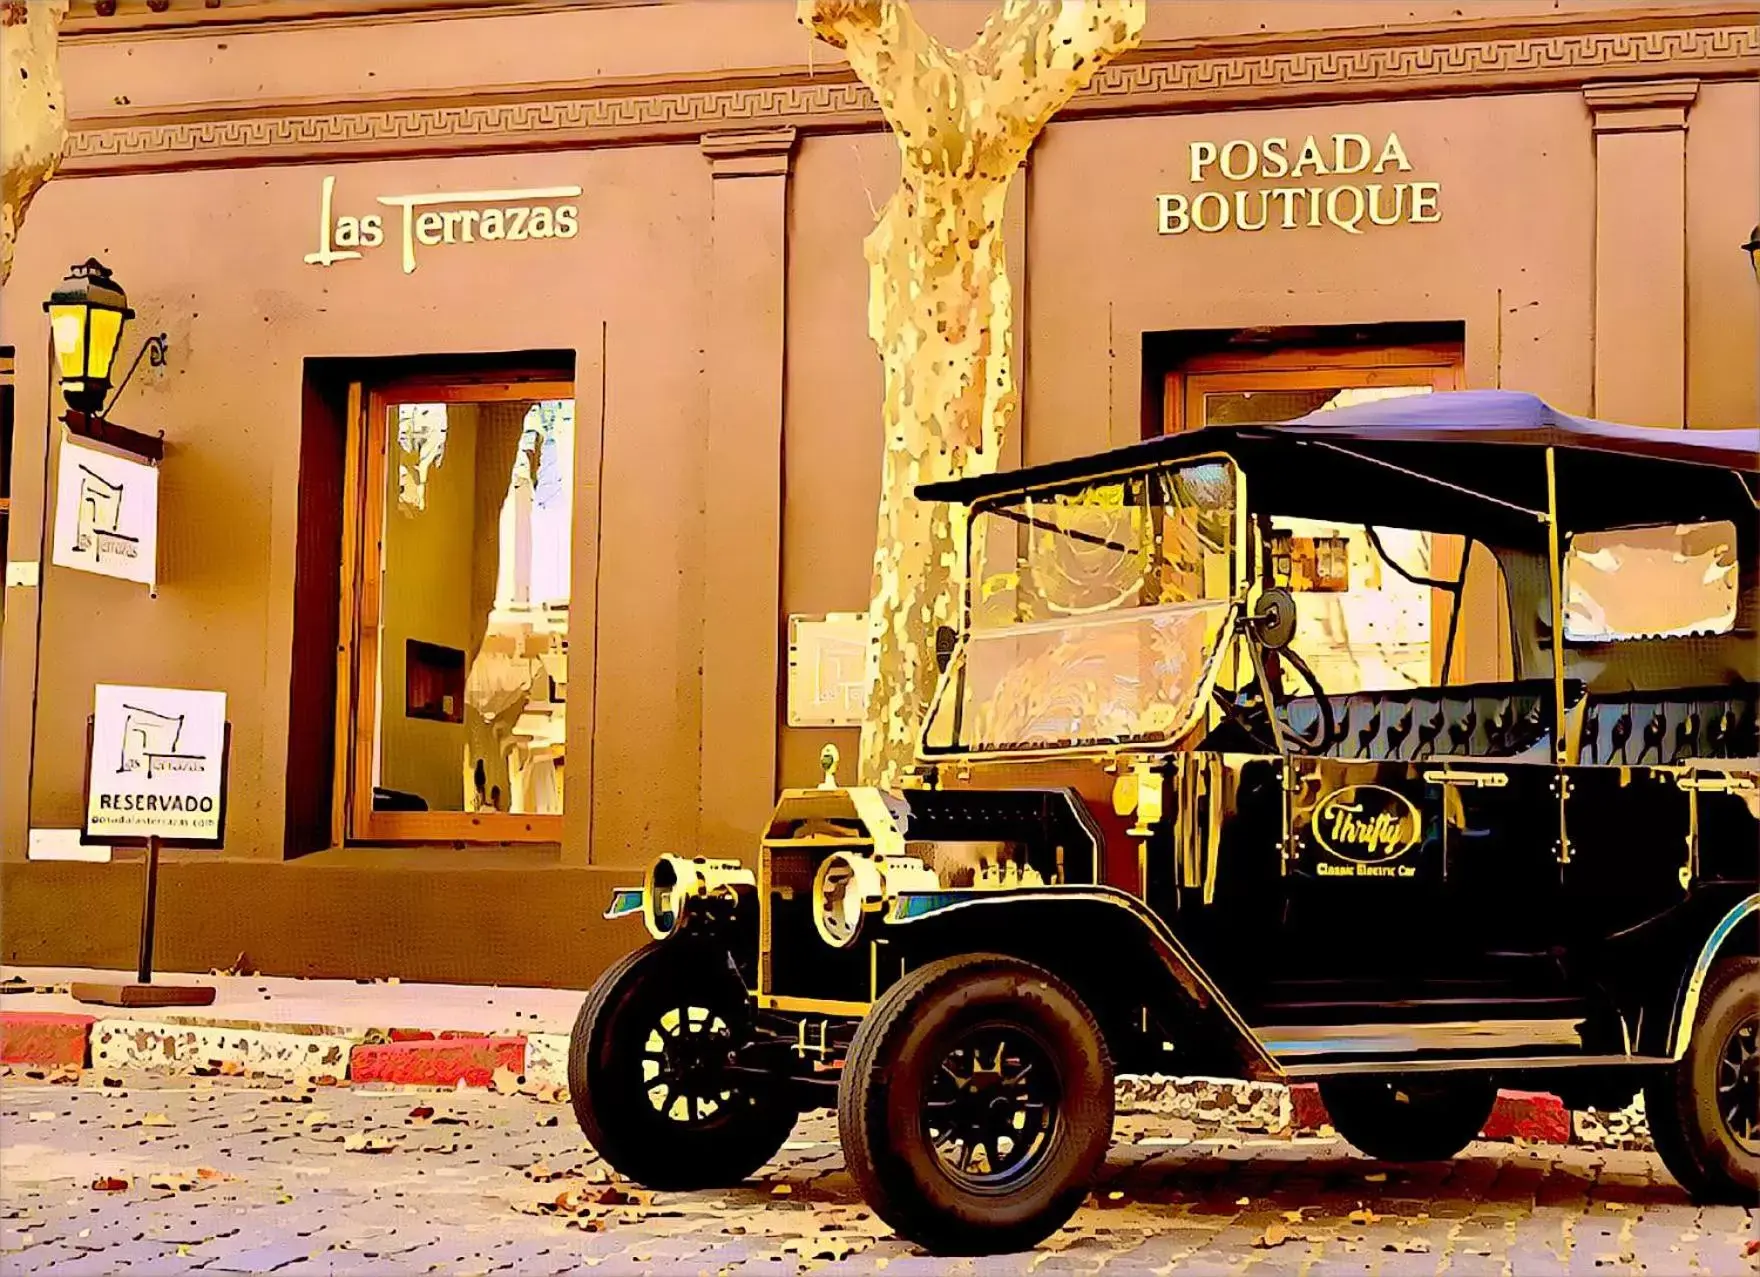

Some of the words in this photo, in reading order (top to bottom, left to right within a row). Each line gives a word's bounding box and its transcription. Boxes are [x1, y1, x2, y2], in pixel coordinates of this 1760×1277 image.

[1189, 132, 1412, 182] POSADA
[304, 176, 384, 266] Las
[376, 185, 583, 274] Terrazas
[1156, 182, 1442, 234] BOUTIQUE
[100, 794, 213, 812] RESERVADO
[1324, 804, 1400, 854] Thrifty
[1317, 863, 1354, 876] Classic
[1357, 863, 1395, 876] Electric
[1398, 865, 1416, 877] Car
